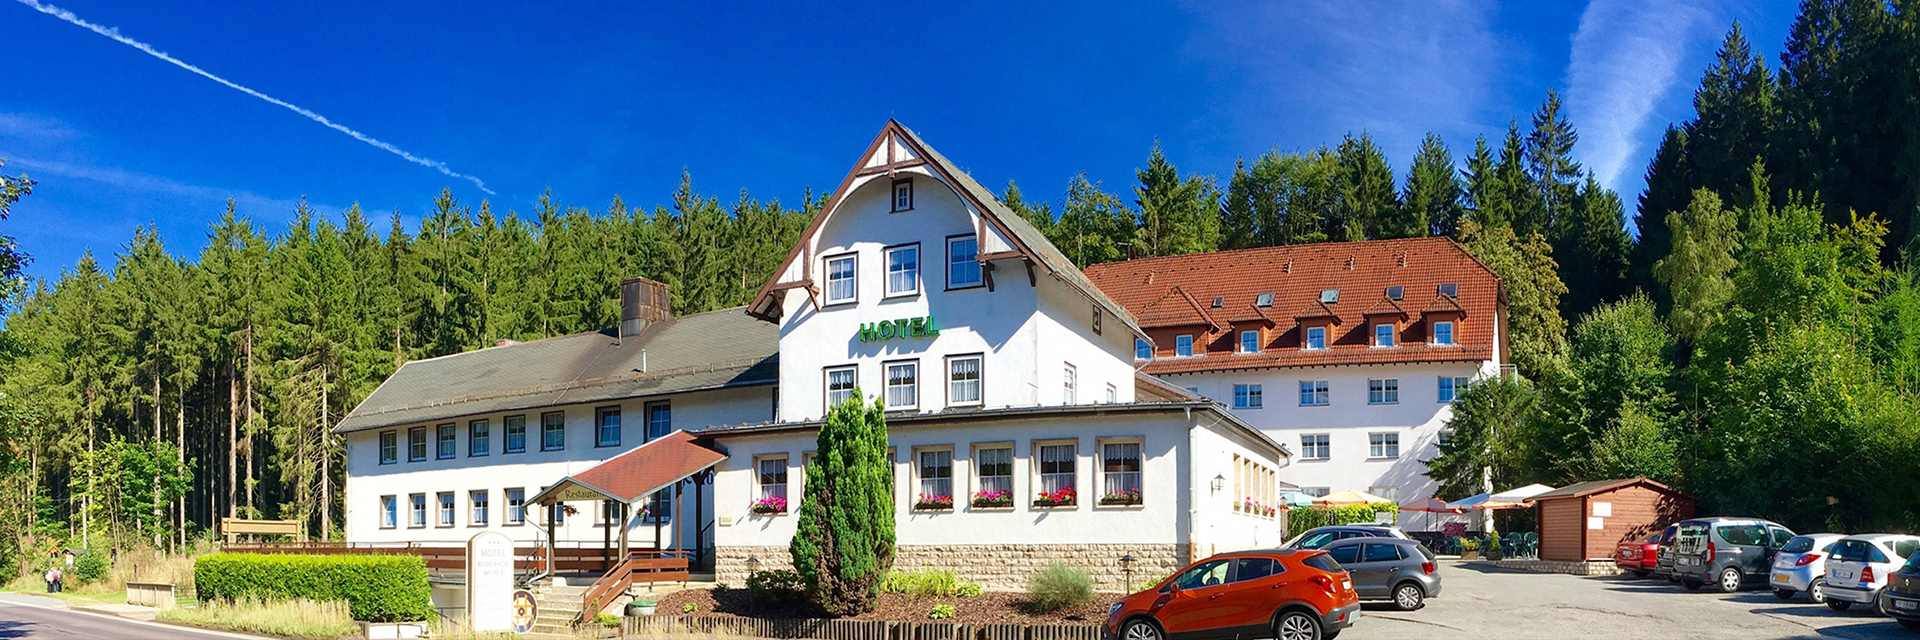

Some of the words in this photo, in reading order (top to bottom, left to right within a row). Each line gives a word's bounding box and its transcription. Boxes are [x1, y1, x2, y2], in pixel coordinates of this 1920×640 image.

[860, 316, 940, 341] HOTEL
[565, 489, 605, 499] Restauran
[481, 549, 506, 557] HOTEL
